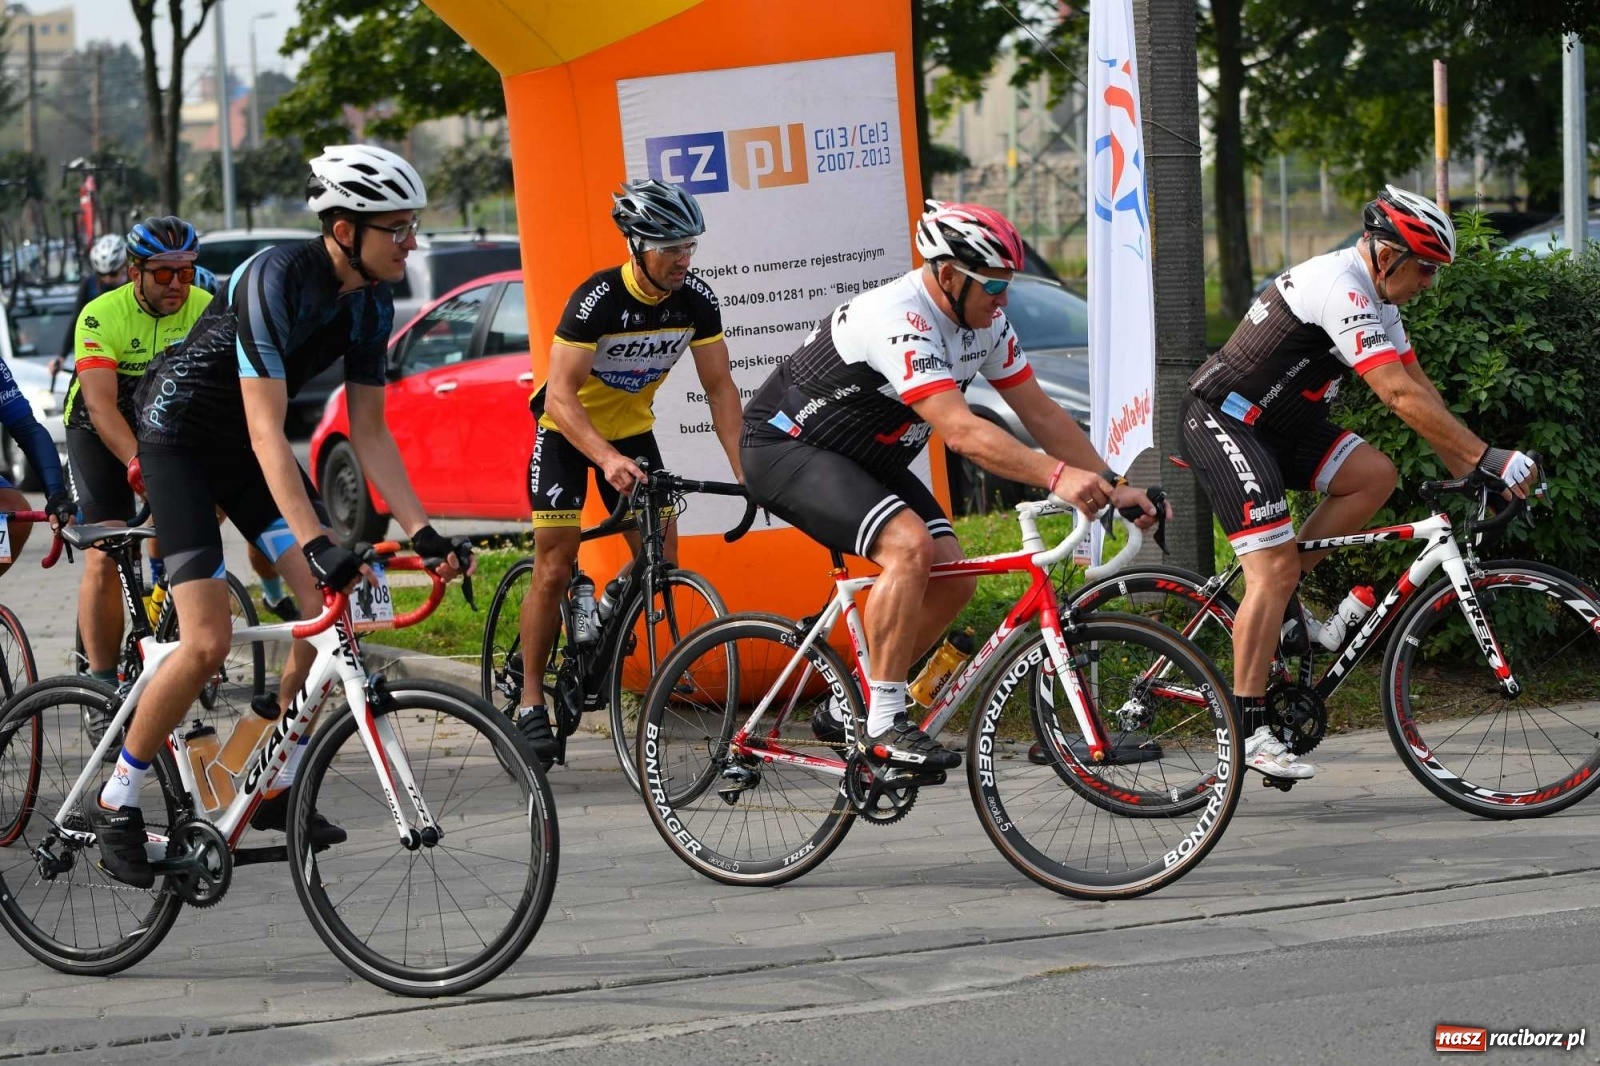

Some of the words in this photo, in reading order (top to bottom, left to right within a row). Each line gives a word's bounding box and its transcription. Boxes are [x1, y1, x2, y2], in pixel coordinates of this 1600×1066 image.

[691, 264, 738, 280] Projekt
[741, 265, 750, 274] o
[754, 257, 807, 274] numerze
[810, 246, 885, 268] rejestracyjnym
[808, 287, 827, 300] pn:
[862, 277, 879, 290] bez
[1204, 413, 1262, 495] TREK
[1303, 532, 1394, 550] TREK
[119, 573, 137, 616] GIANT
[1327, 586, 1400, 678] TREK
[1459, 577, 1502, 664] TREK
[944, 618, 1013, 707] TREK
[978, 647, 1045, 788] BONTRAGER
[385, 788, 403, 828] GIANT
[645, 721, 702, 855] BONTRAGER
[1163, 727, 1231, 869] BONTRAGER
[1000, 822, 1013, 833] 5
[707, 855, 732, 870] aeolus
[732, 860, 741, 873] 5
[782, 840, 816, 866] TREK
